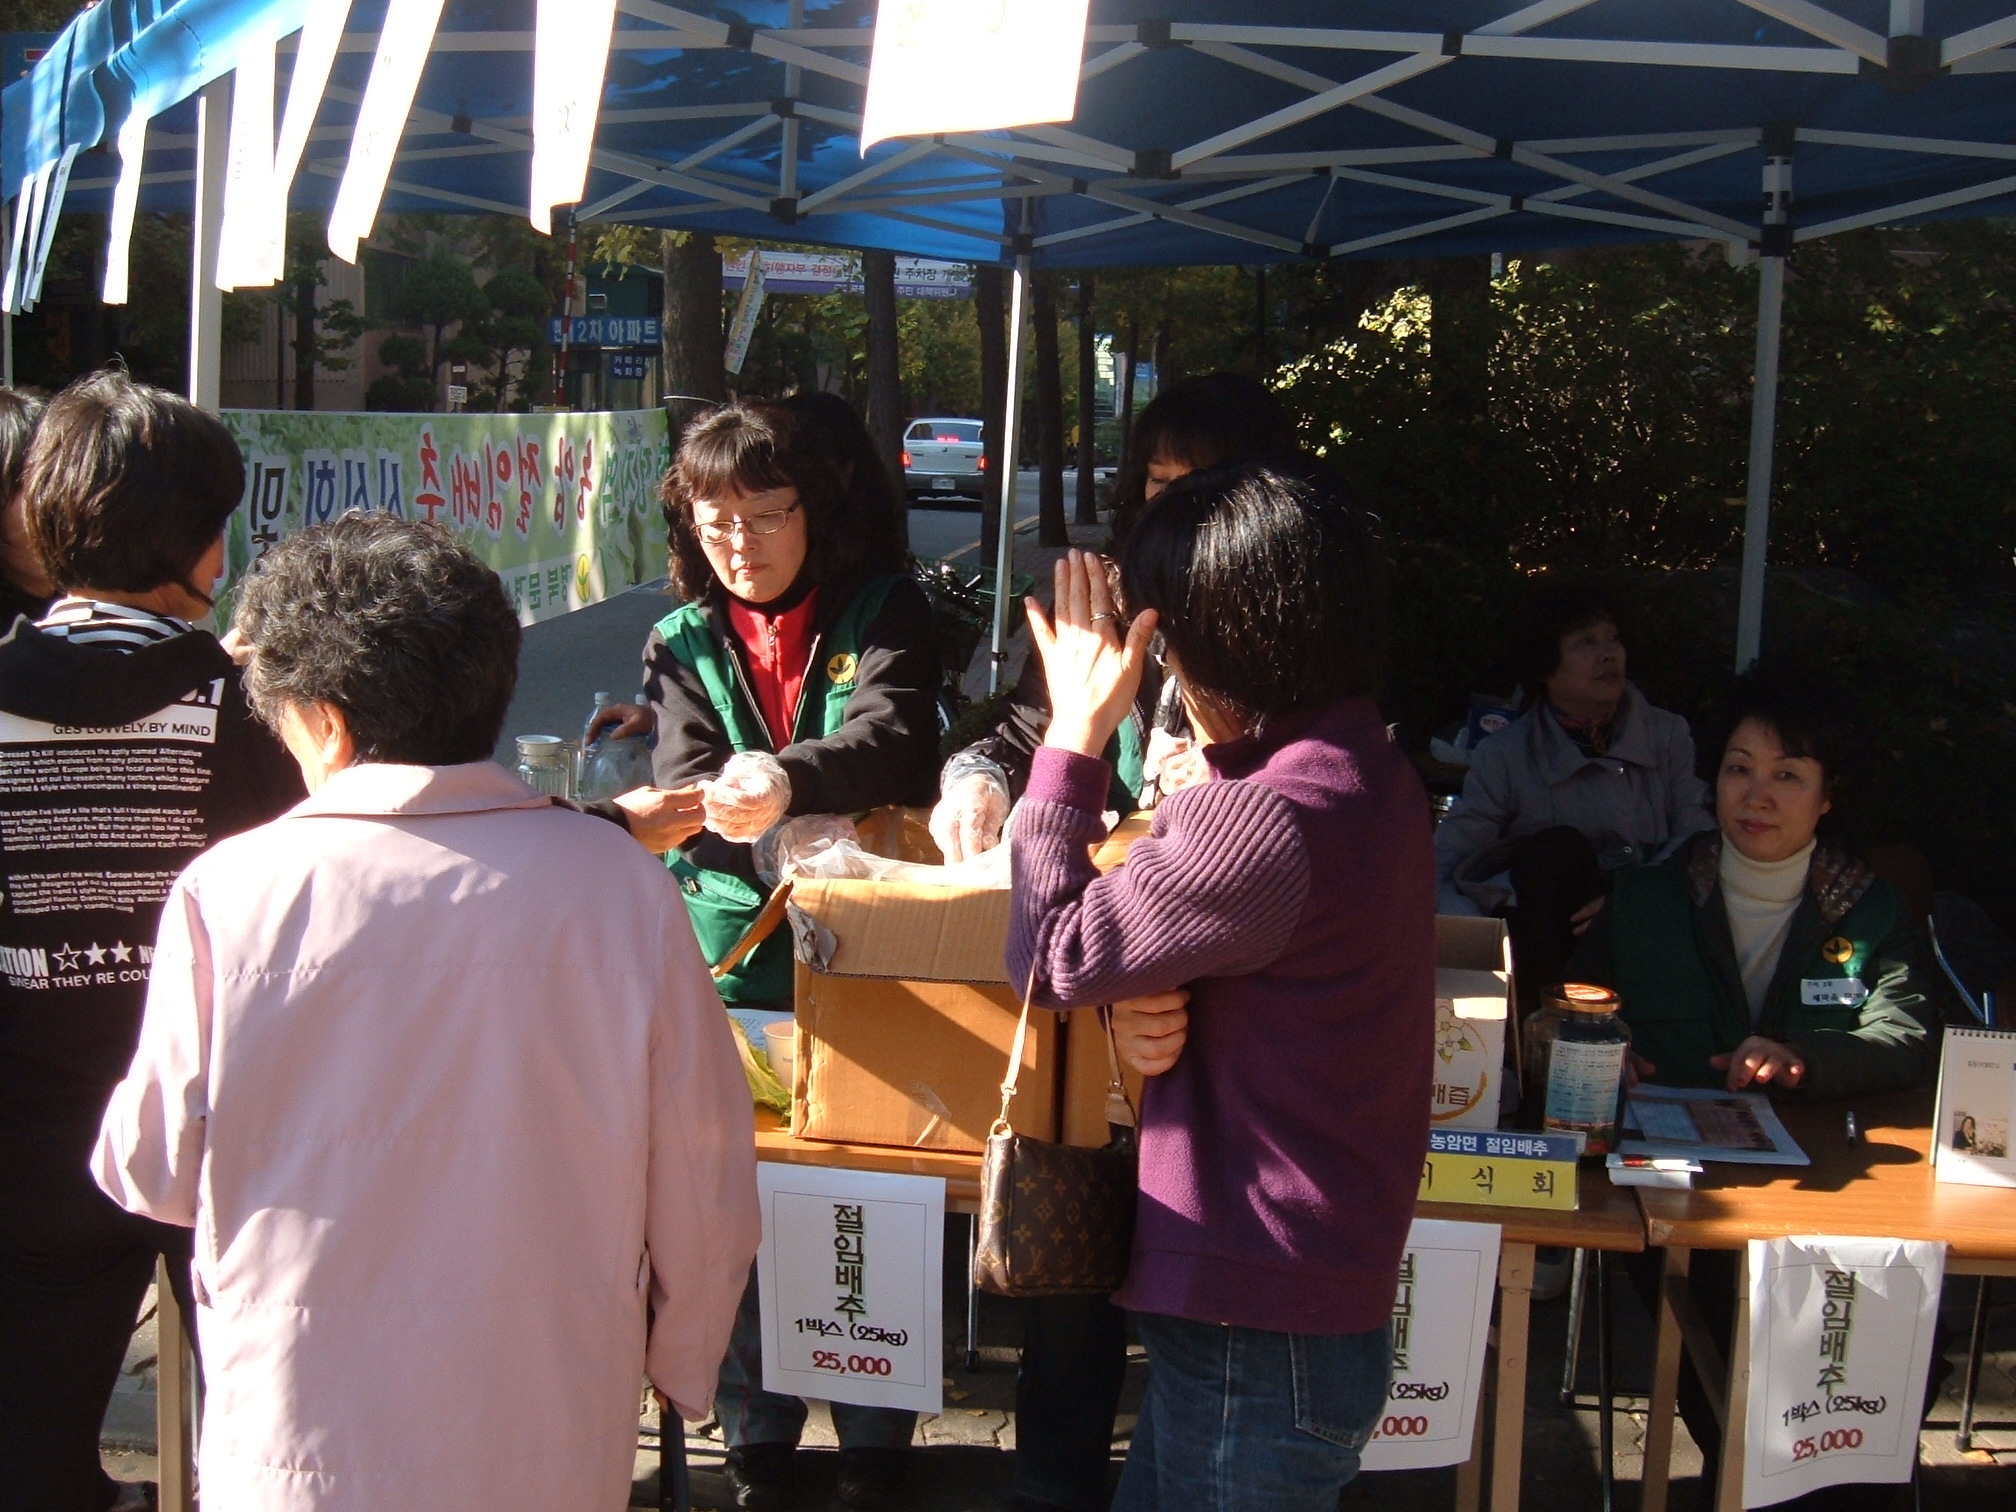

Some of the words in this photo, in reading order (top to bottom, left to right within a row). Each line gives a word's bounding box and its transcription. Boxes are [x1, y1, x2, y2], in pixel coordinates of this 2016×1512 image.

[905, 267, 937, 280] 주차장
[609, 319, 658, 344] 아파트
[171, 722, 211, 737] MIND
[52, 973, 91, 988] THEY
[96, 972, 115, 984] RE
[1430, 1132, 1478, 1153] 농암면
[1485, 1138, 1548, 1157] 절임배추
[833, 1203, 866, 1322] 절임배추
[794, 1318, 844, 1337] 1박스
[849, 1322, 909, 1347] (25kg)
[1816, 1269, 1857, 1395] 절임배추
[812, 1349, 892, 1377] 25,000
[1389, 1381, 1450, 1402] (25kg)
[1782, 1399, 1821, 1427] 1박스
[1825, 1394, 1887, 1416] (25kg)
[1372, 1415, 1428, 1440] ,000
[1792, 1428, 1864, 1463] 25,000
